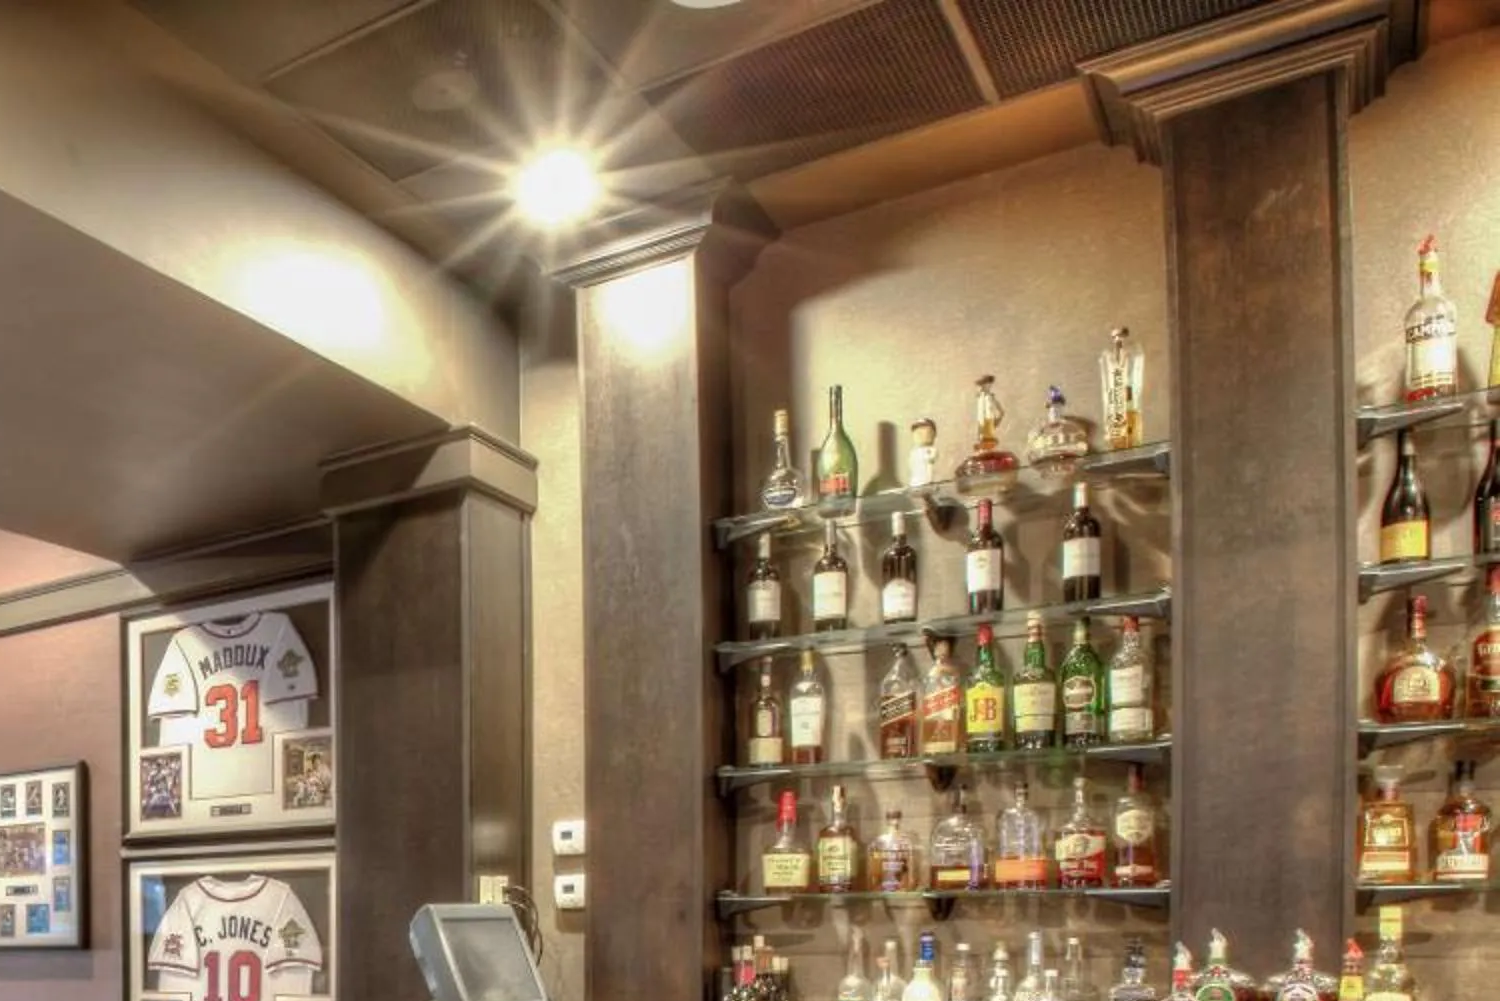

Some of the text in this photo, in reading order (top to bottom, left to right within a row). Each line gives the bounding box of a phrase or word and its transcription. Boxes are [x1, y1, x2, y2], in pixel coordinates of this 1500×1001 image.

[199, 644, 269, 679] MADDUX
[204, 679, 263, 748] 31
[194, 915, 273, 947] C. JONES
